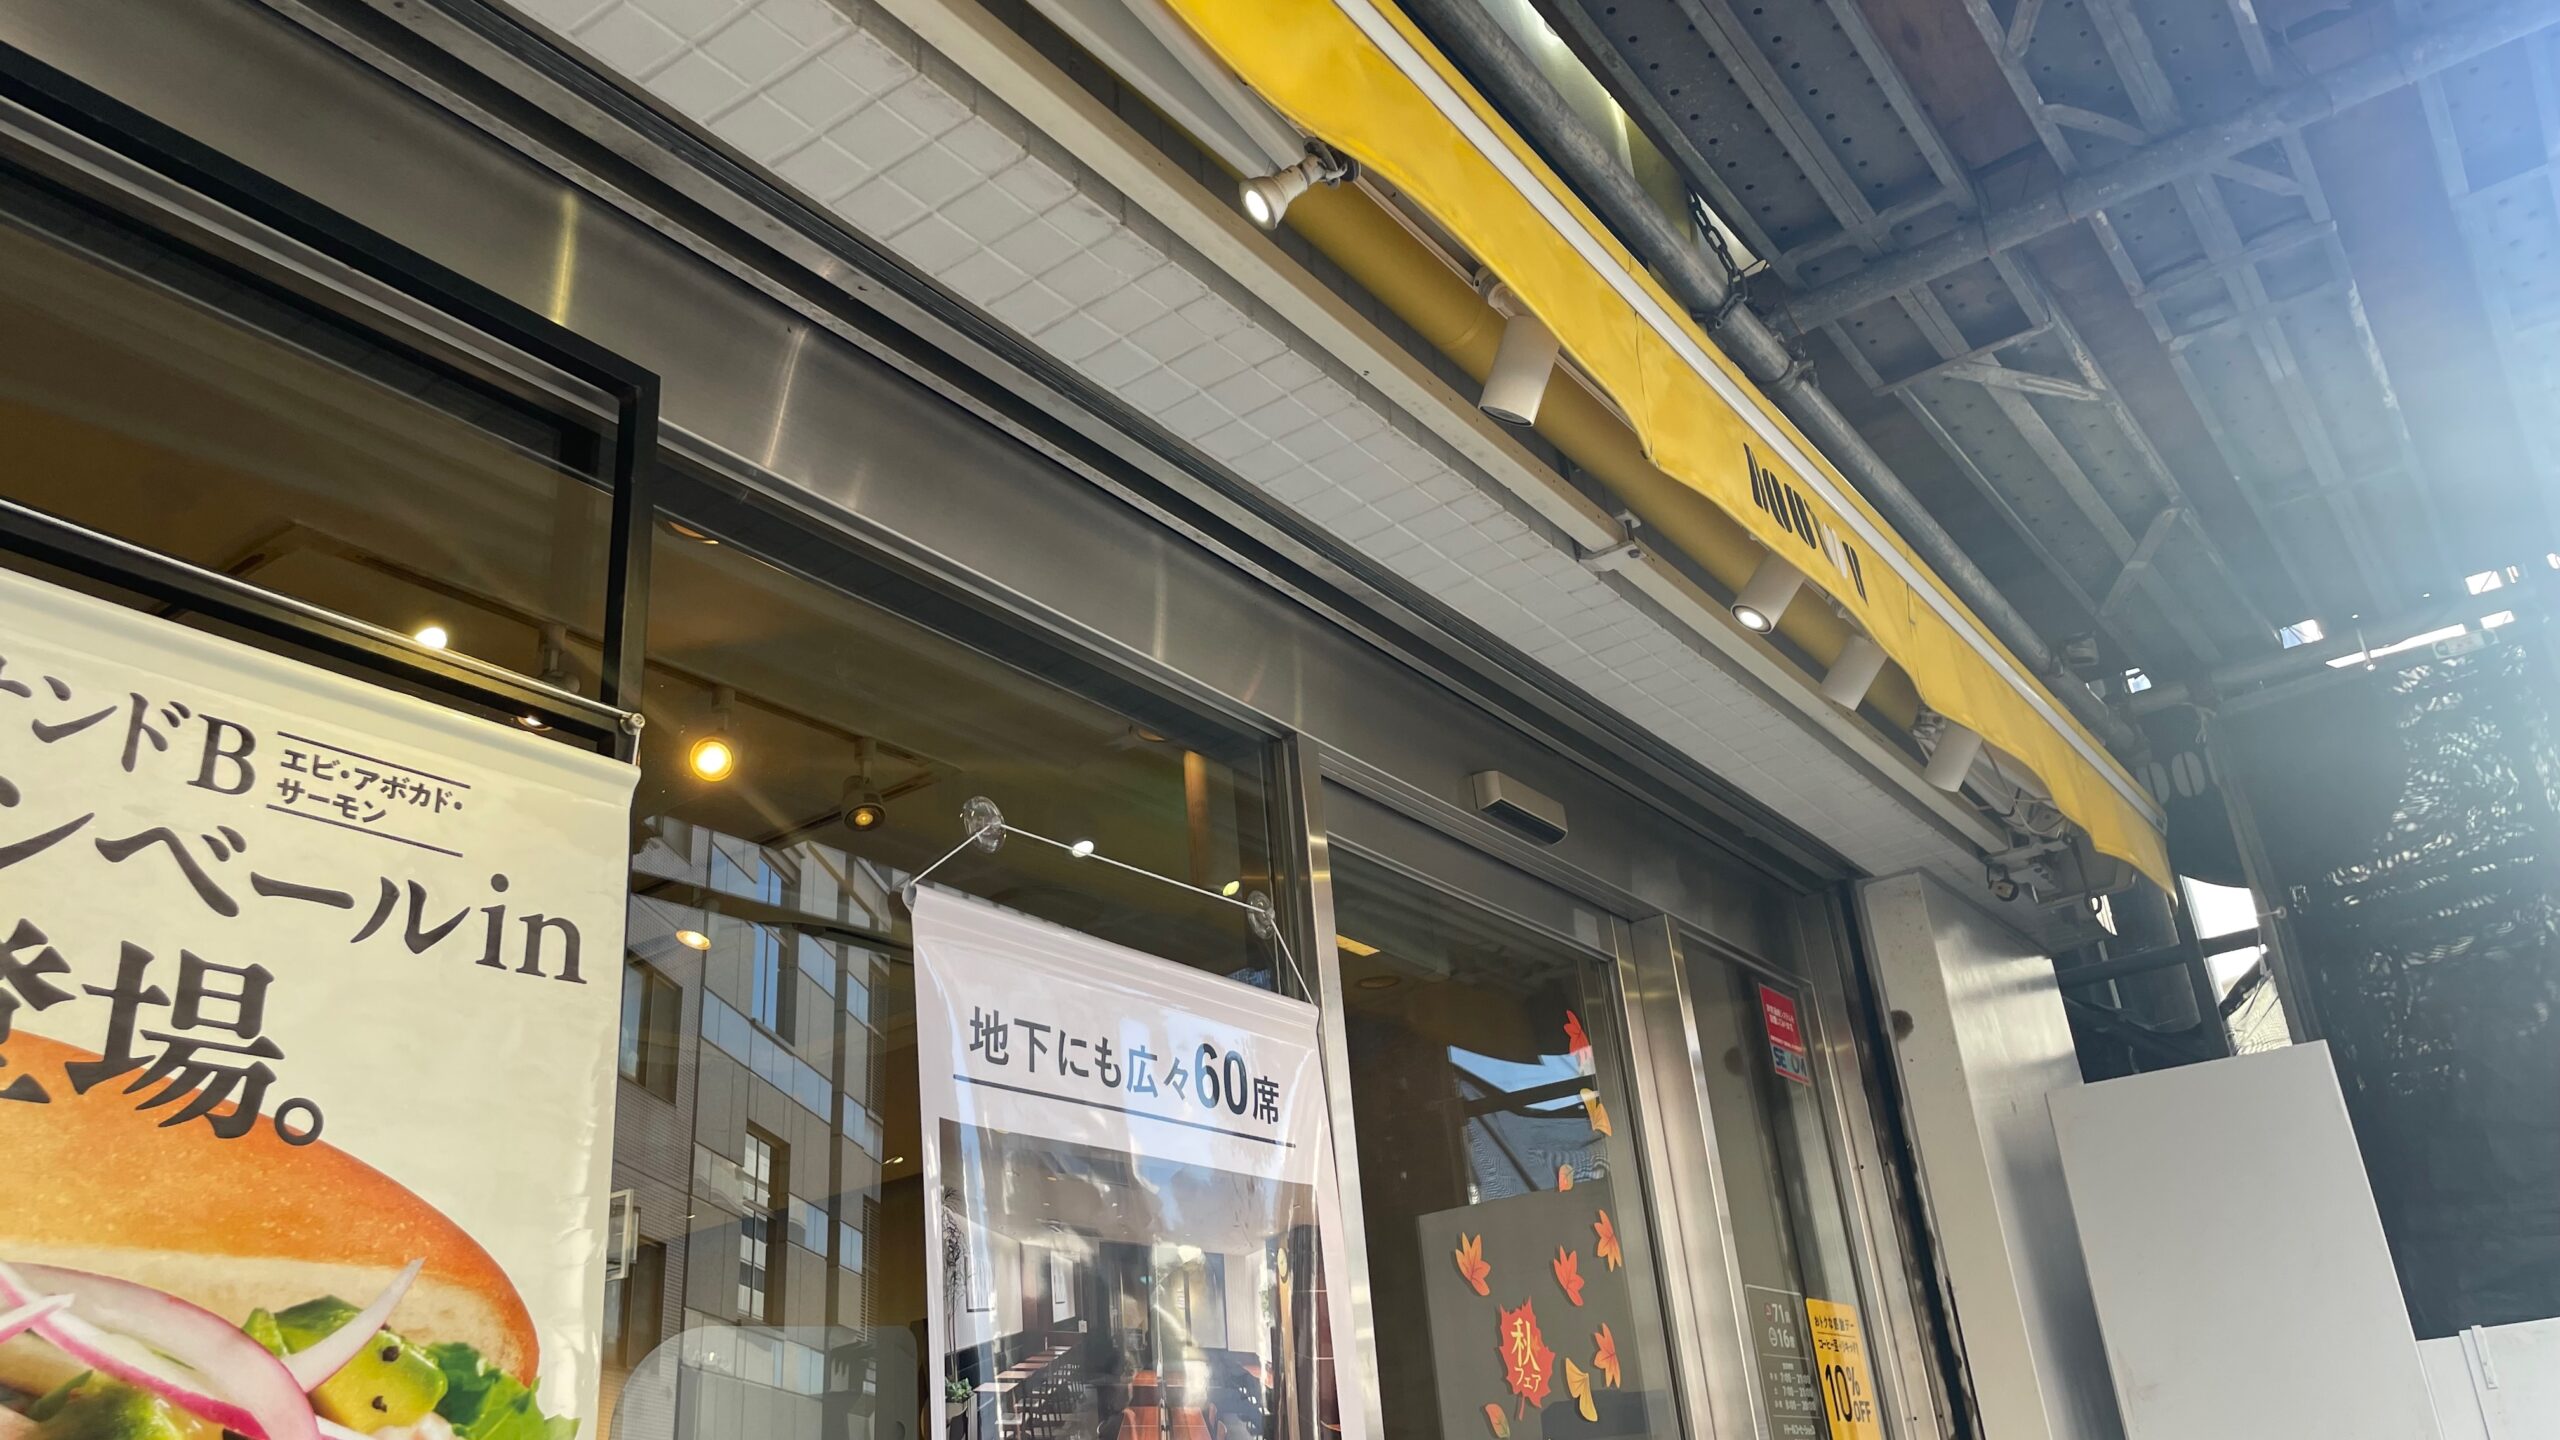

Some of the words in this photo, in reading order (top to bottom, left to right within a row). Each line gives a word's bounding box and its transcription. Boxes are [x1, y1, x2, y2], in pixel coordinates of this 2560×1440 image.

[276, 777, 387, 823] サーモン
[280, 749, 463, 814] エビ・アボカド・
[970, 1006, 1280, 1125] 地下にも広々60席
[1510, 1317, 1541, 1371] 秋
[1513, 1366, 1542, 1393] フェア
[1825, 1364, 1860, 1422] 10%
[1853, 1401, 1871, 1422] OFF
